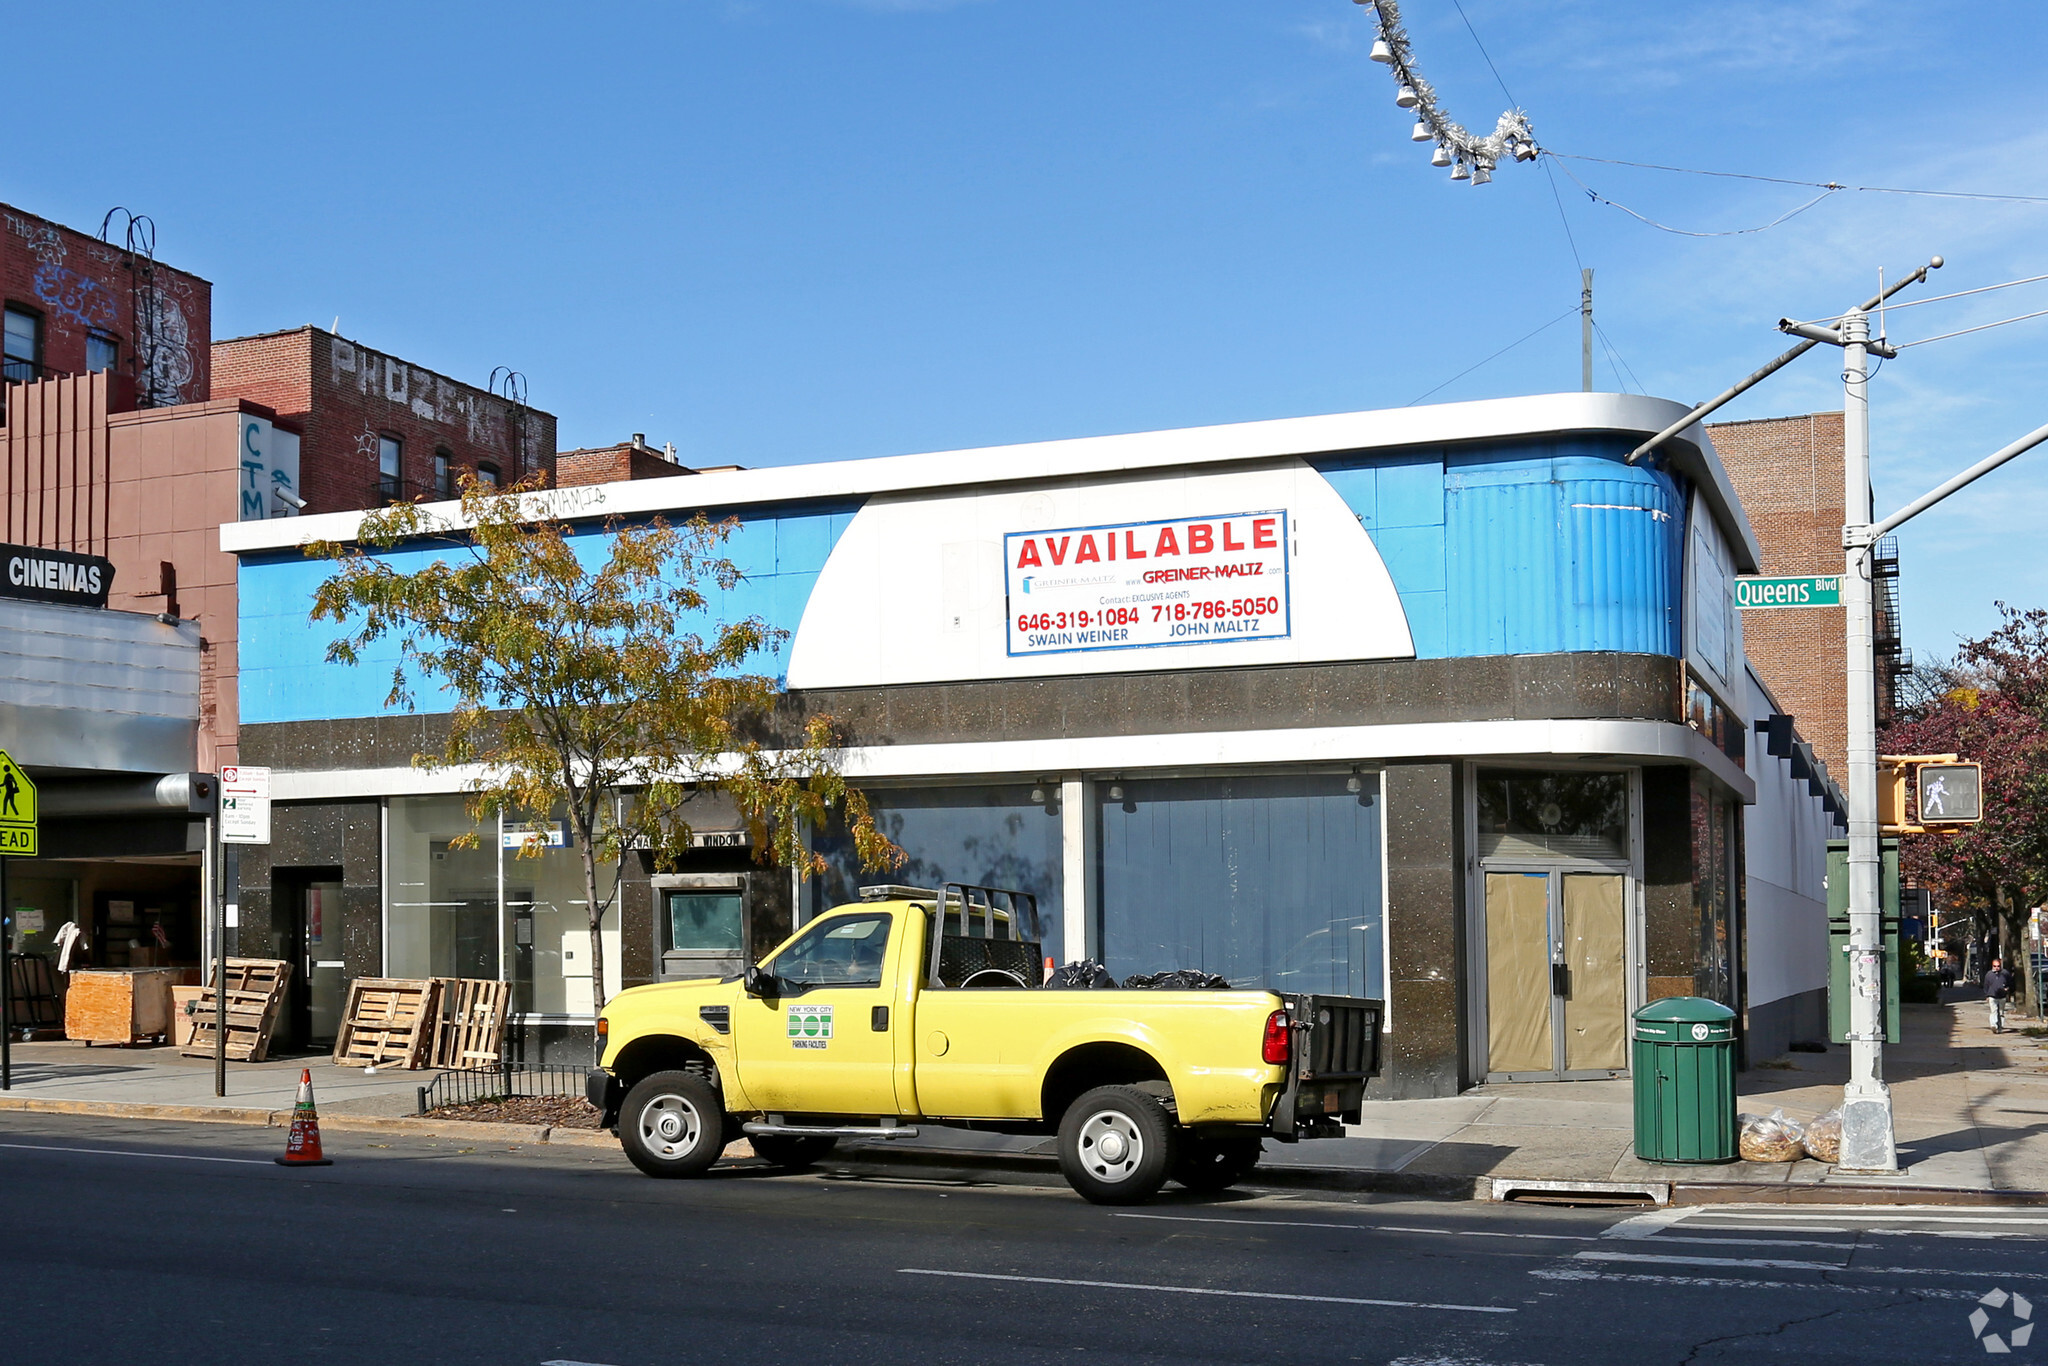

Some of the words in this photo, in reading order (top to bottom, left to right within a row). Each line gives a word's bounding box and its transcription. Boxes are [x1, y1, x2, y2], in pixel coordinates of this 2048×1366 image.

[1017, 518, 1277, 569] AVAILABLE
[9, 556, 102, 595] CINEMAS
[1099, 596, 1131, 606] Contact:
[1132, 591, 1164, 603] EXCLUSIVE
[1165, 590, 1190, 600] AGENTS
[1737, 581, 1810, 606] Queens
[1815, 579, 1837, 592] Blvd
[1028, 632, 1072, 647] SWAIN
[1076, 628, 1129, 644] WEINER
[1169, 622, 1209, 637] JOHN
[1213, 618, 1260, 634] MALTZ
[225, 798, 234, 809] 2
[703, 834, 740, 847] WINDOW
[788, 1014, 832, 1036] DOT
